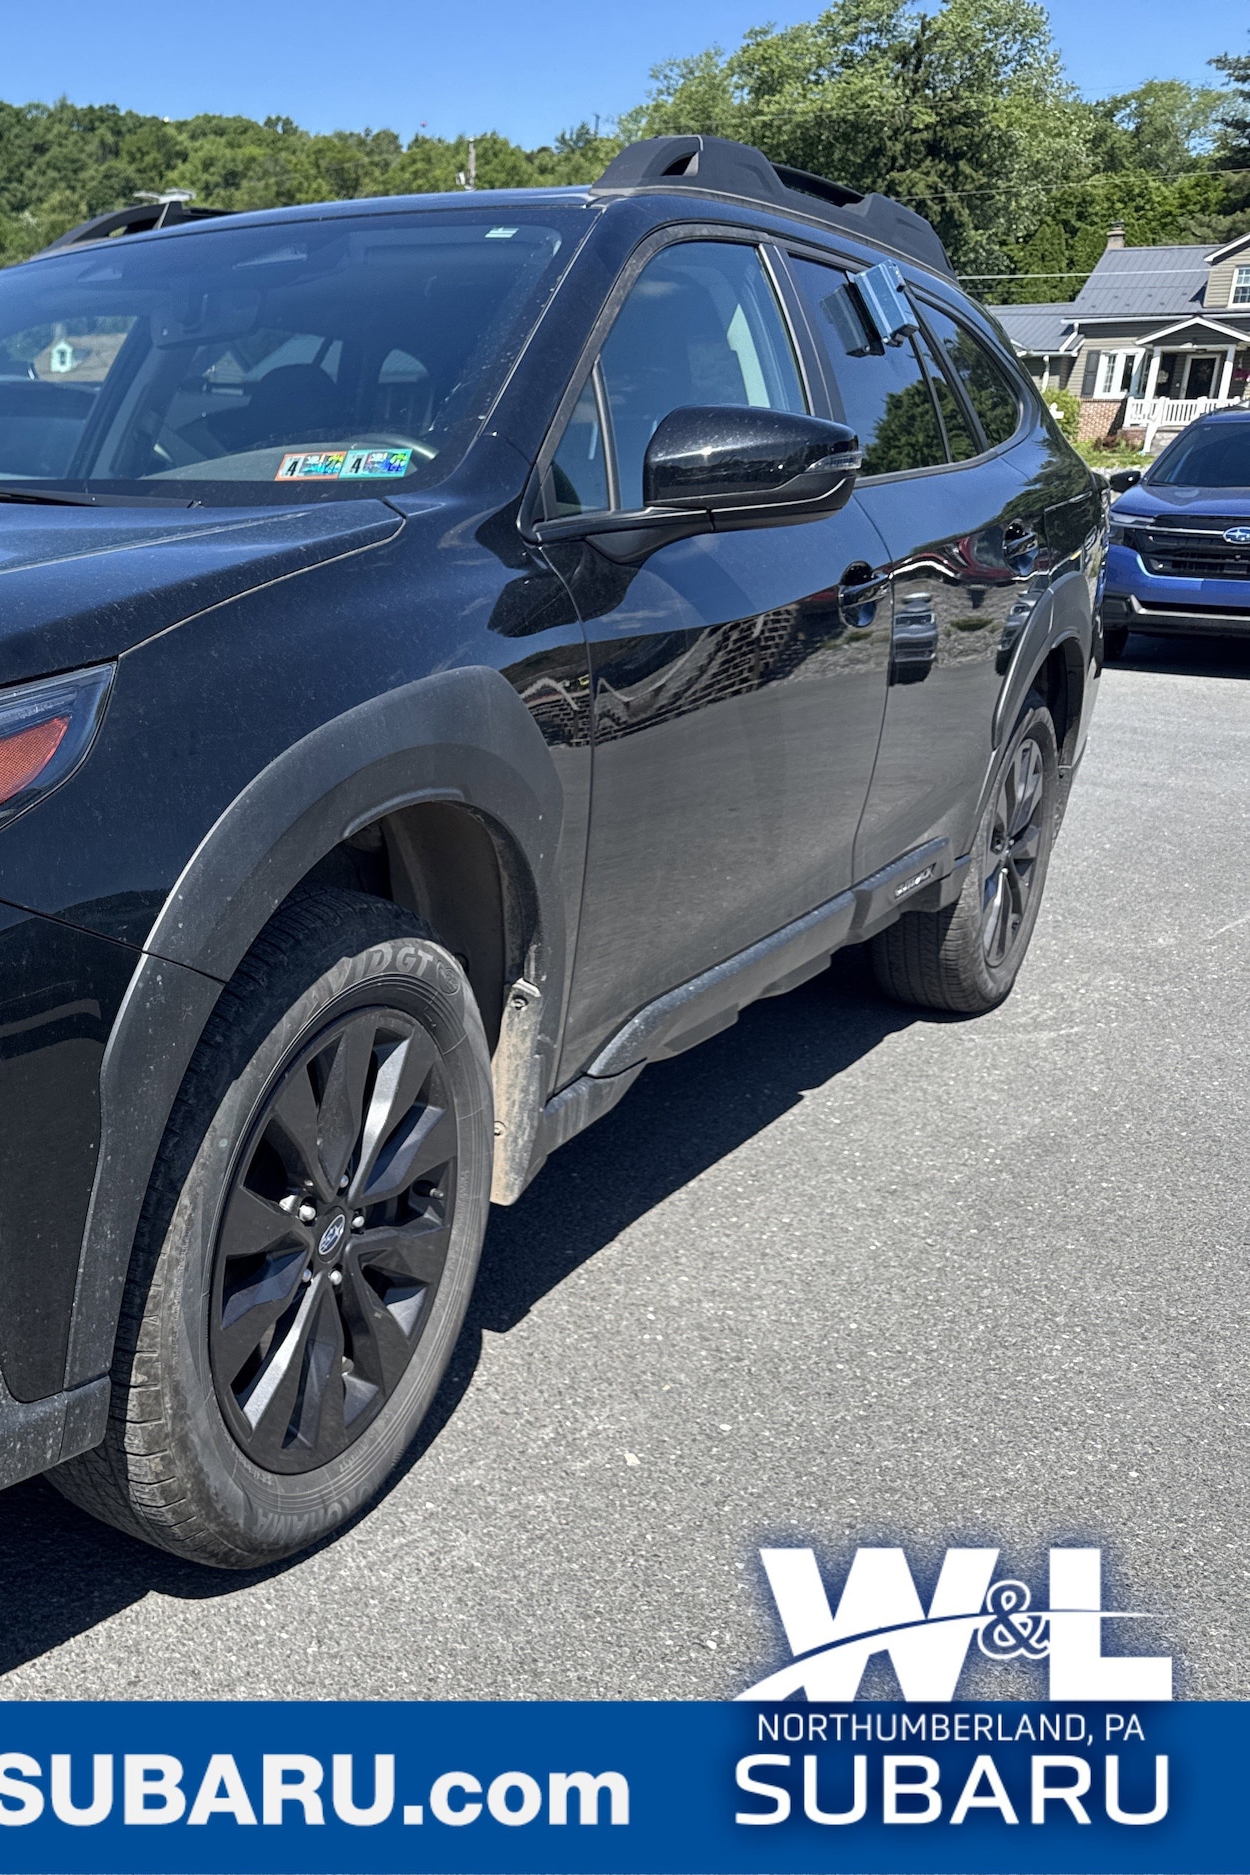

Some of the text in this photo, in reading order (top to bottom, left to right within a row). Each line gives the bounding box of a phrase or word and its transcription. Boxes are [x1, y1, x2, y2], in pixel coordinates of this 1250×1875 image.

[286, 460, 299, 477] 4
[349, 457, 363, 474] 4
[396, 946, 433, 976] GT
